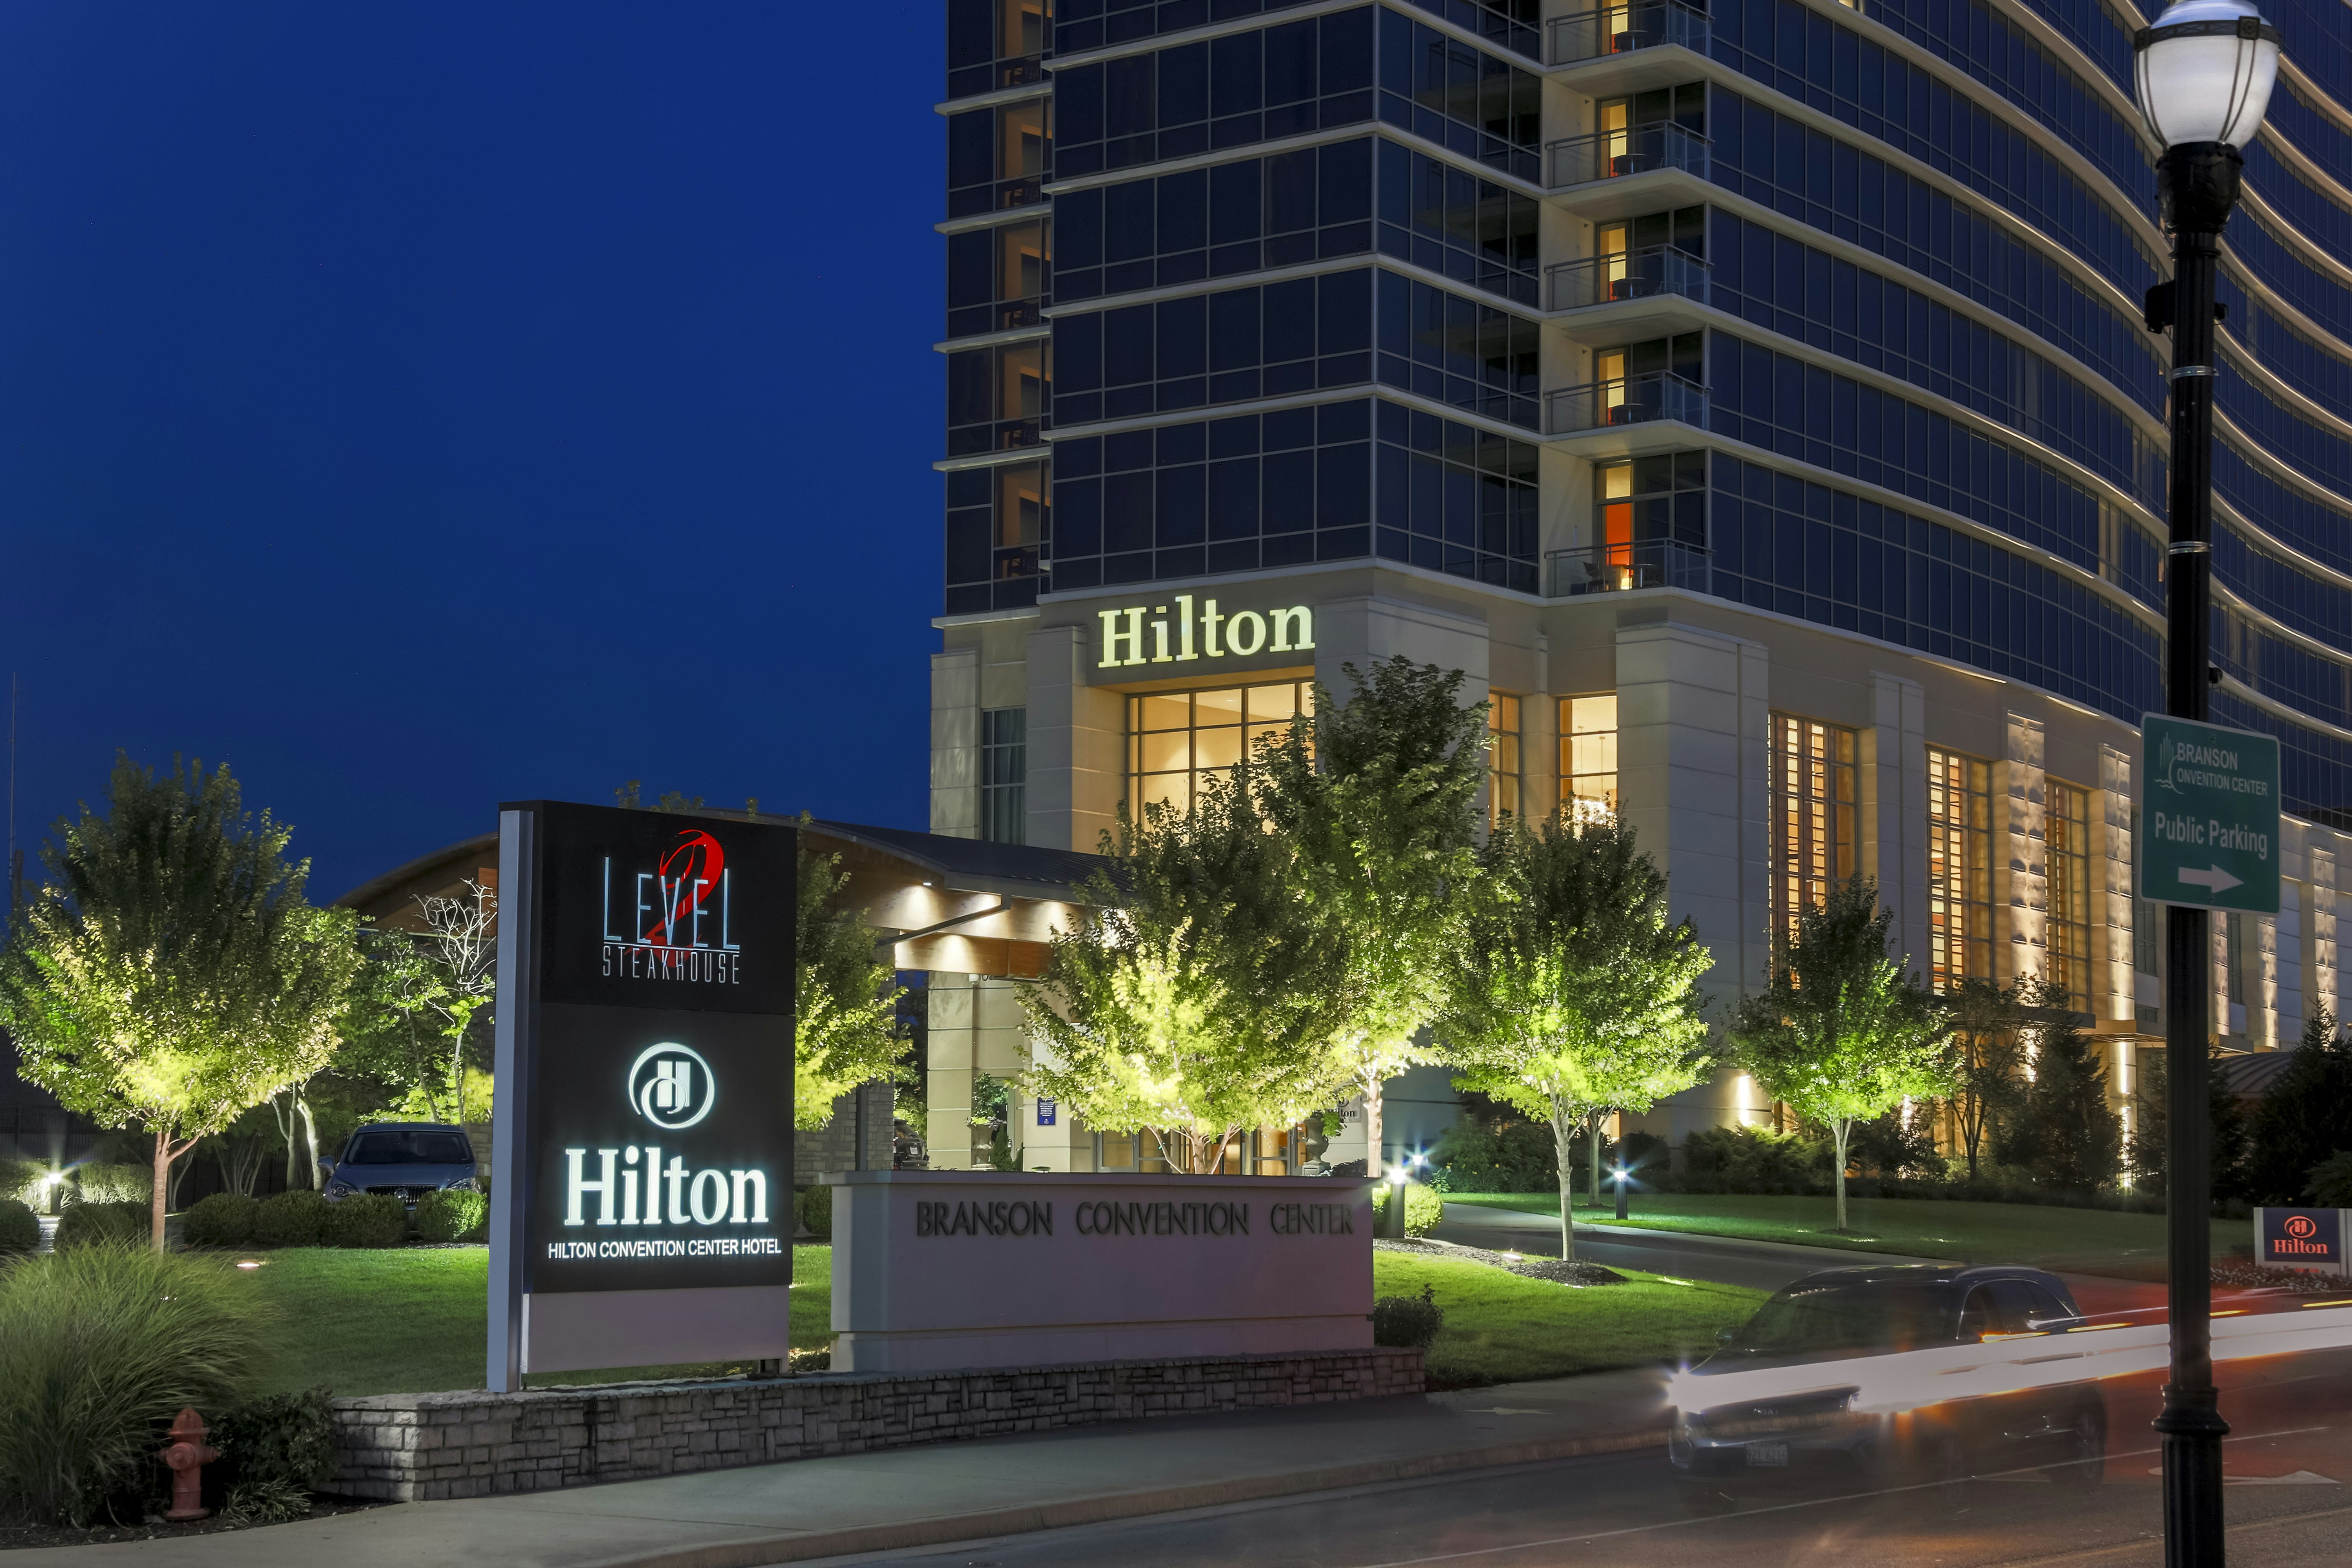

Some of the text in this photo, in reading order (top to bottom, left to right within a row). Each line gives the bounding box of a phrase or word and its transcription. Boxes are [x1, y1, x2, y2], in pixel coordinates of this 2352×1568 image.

[1098, 595, 1316, 668] Hilton
[2177, 742, 2238, 770] BRANSON
[2232, 779, 2267, 797] CENTER
[2155, 811, 2267, 860] Public Parking
[604, 856, 739, 949] LEVEL
[603, 946, 739, 984] STEAKHOUSE
[564, 1146, 769, 1226] Hilton
[917, 1201, 1354, 1236] BRANSON CONVENTION CENTER
[548, 1238, 782, 1259] HILTON CONVENTION CENTER HOTEL
[2273, 1238, 2328, 1254] Hilton
